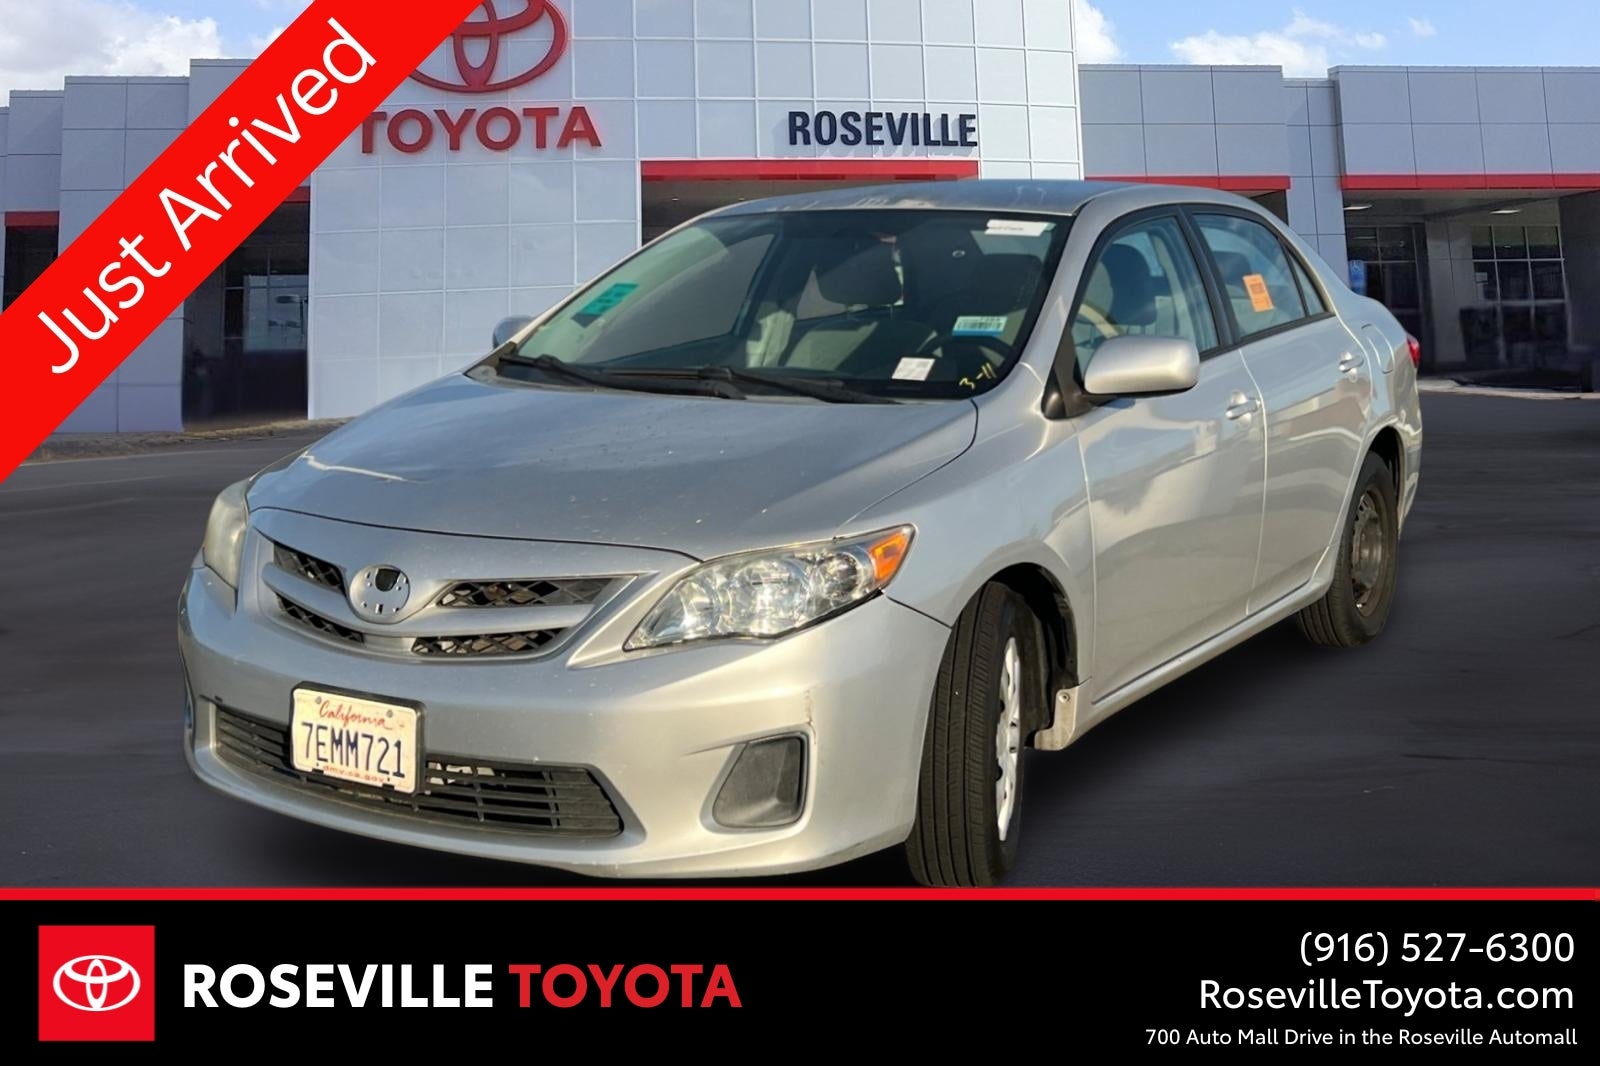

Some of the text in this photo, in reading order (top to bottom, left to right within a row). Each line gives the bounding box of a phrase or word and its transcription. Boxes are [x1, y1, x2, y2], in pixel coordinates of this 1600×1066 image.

[361, 106, 602, 154] TOYOTA
[788, 110, 978, 147] ROSEVILLE
[319, 699, 393, 730] California
[301, 721, 405, 779] 7EMM721
